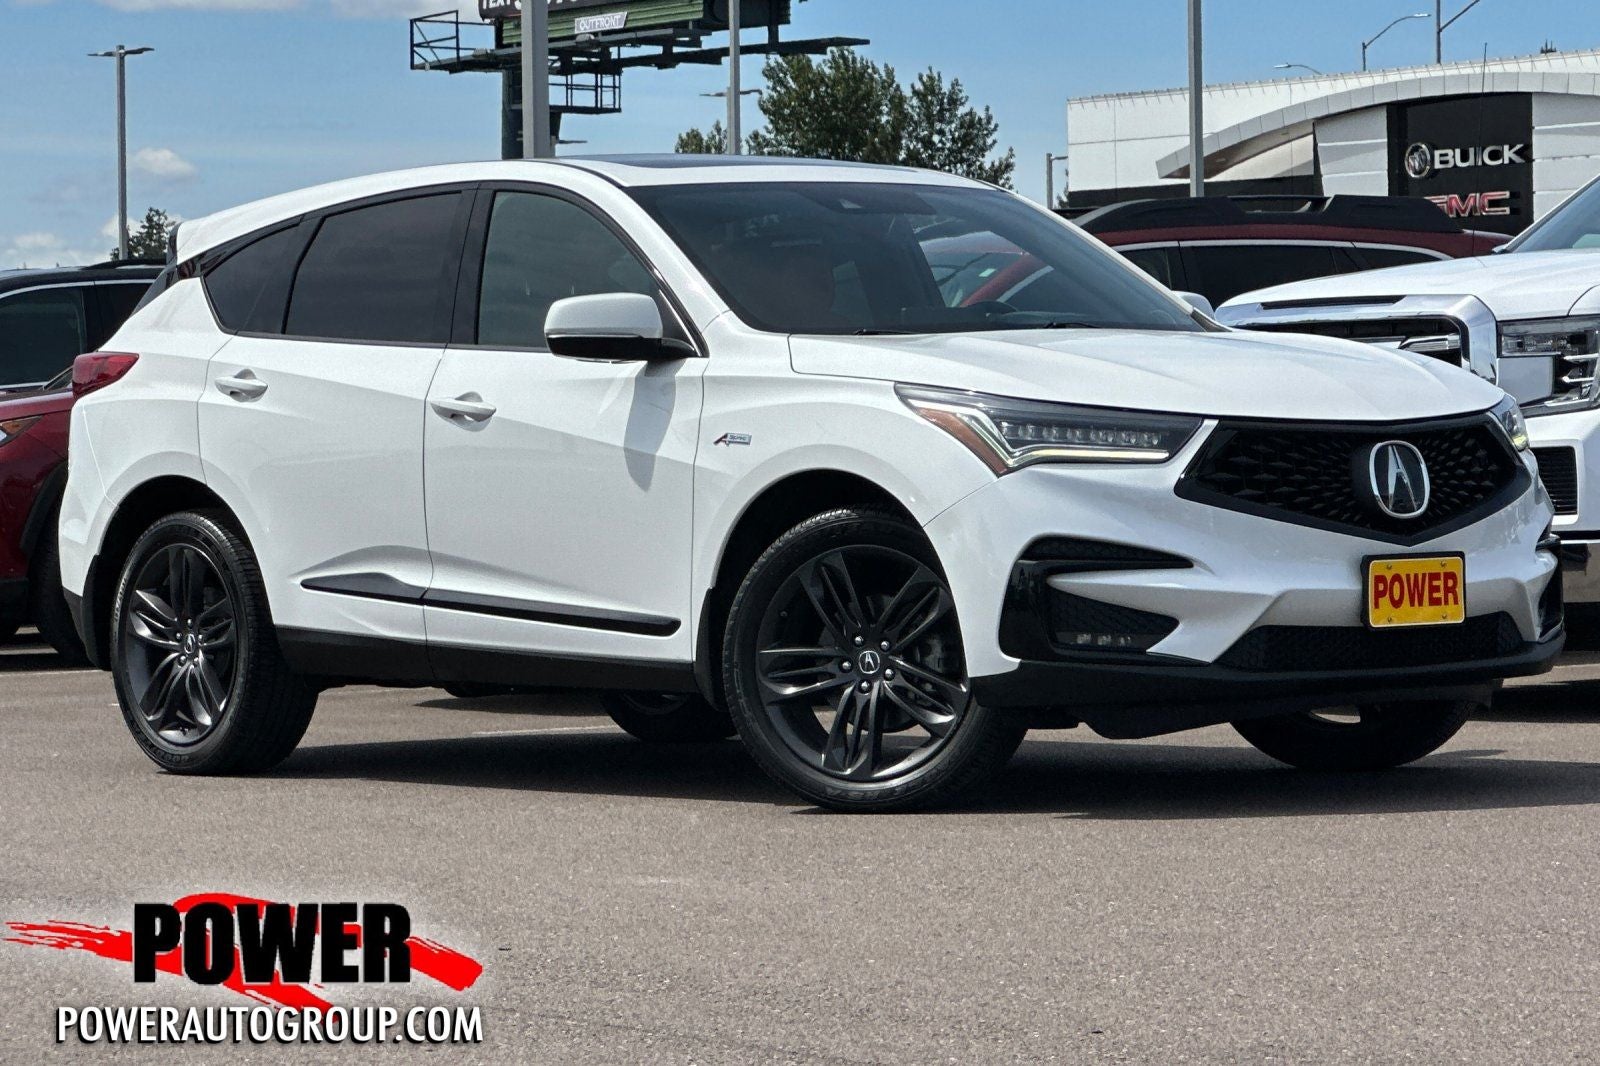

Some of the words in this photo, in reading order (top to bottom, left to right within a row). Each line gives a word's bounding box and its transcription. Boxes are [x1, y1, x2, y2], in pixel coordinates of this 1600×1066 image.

[579, 15, 622, 31] OUTFRONT
[1434, 143, 1525, 169] BUICK
[1373, 571, 1459, 609] POWER
